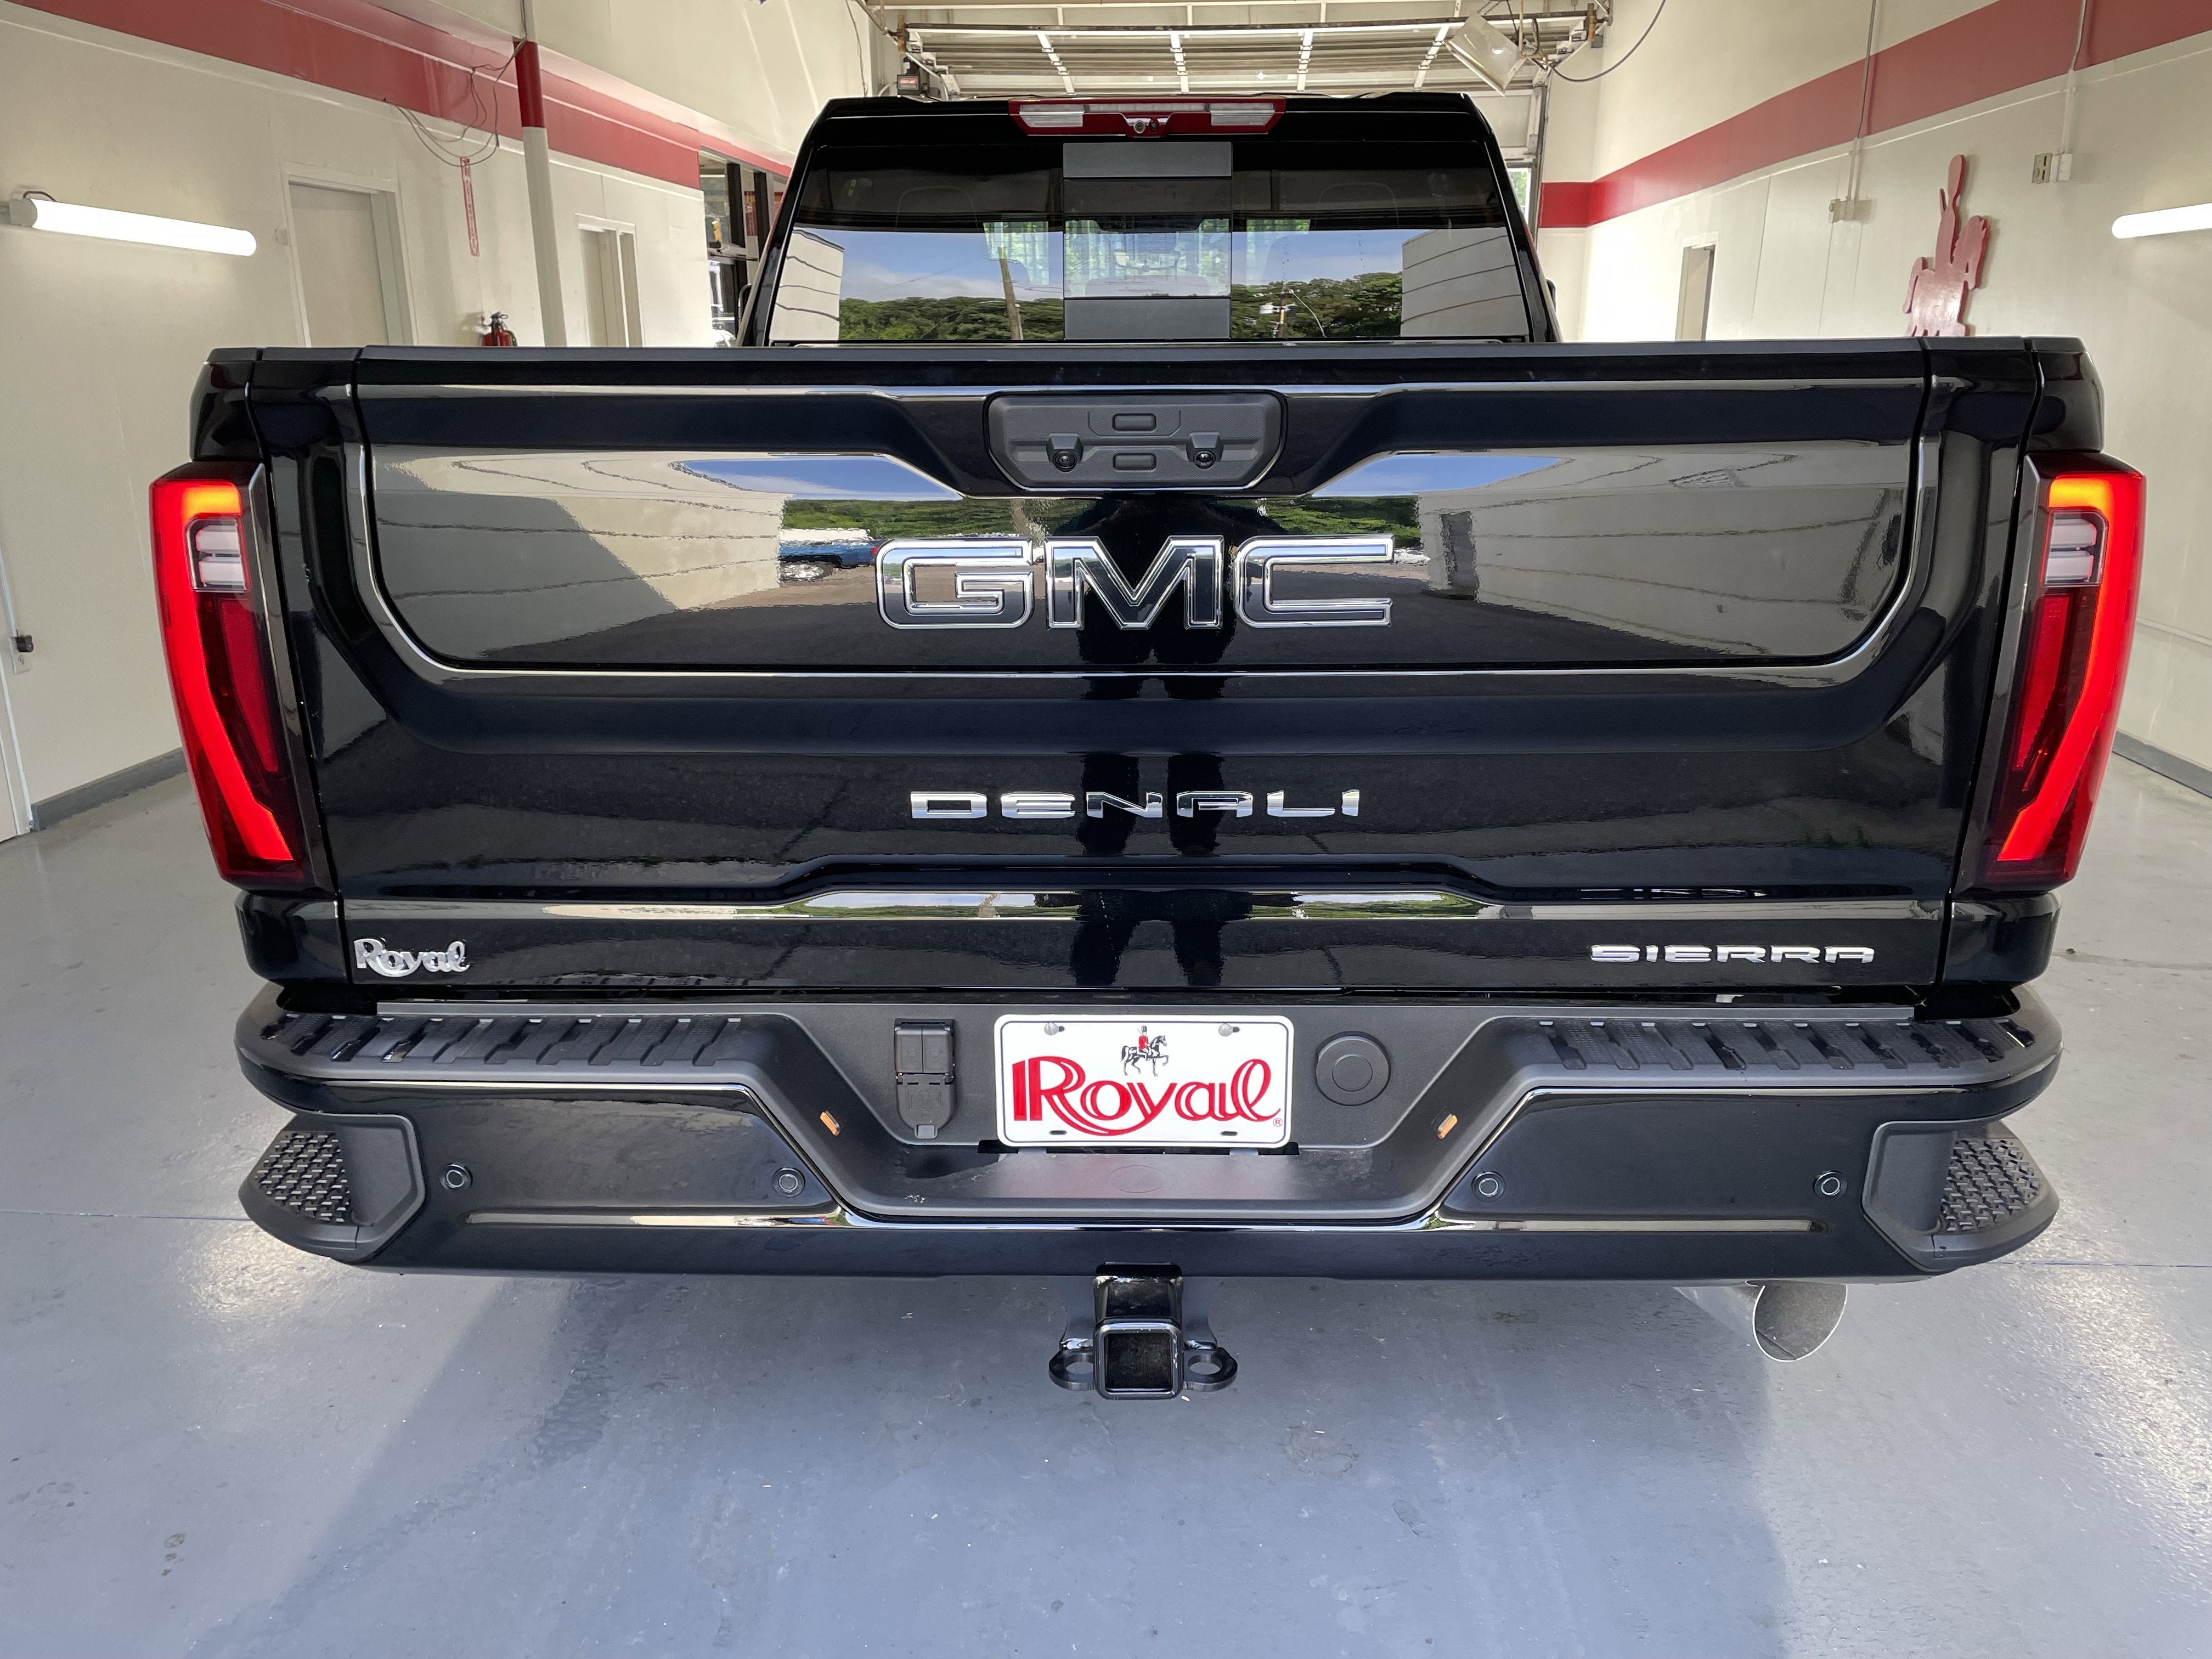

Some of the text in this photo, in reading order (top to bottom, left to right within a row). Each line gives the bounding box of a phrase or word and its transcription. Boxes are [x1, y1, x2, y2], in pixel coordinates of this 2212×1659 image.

[876, 535, 1395, 630] GMC
[910, 789, 1360, 819] DENALI
[354, 938, 470, 977] Royal
[1590, 944, 1875, 963] SIERRA
[1012, 1056, 1281, 1136] Royal
